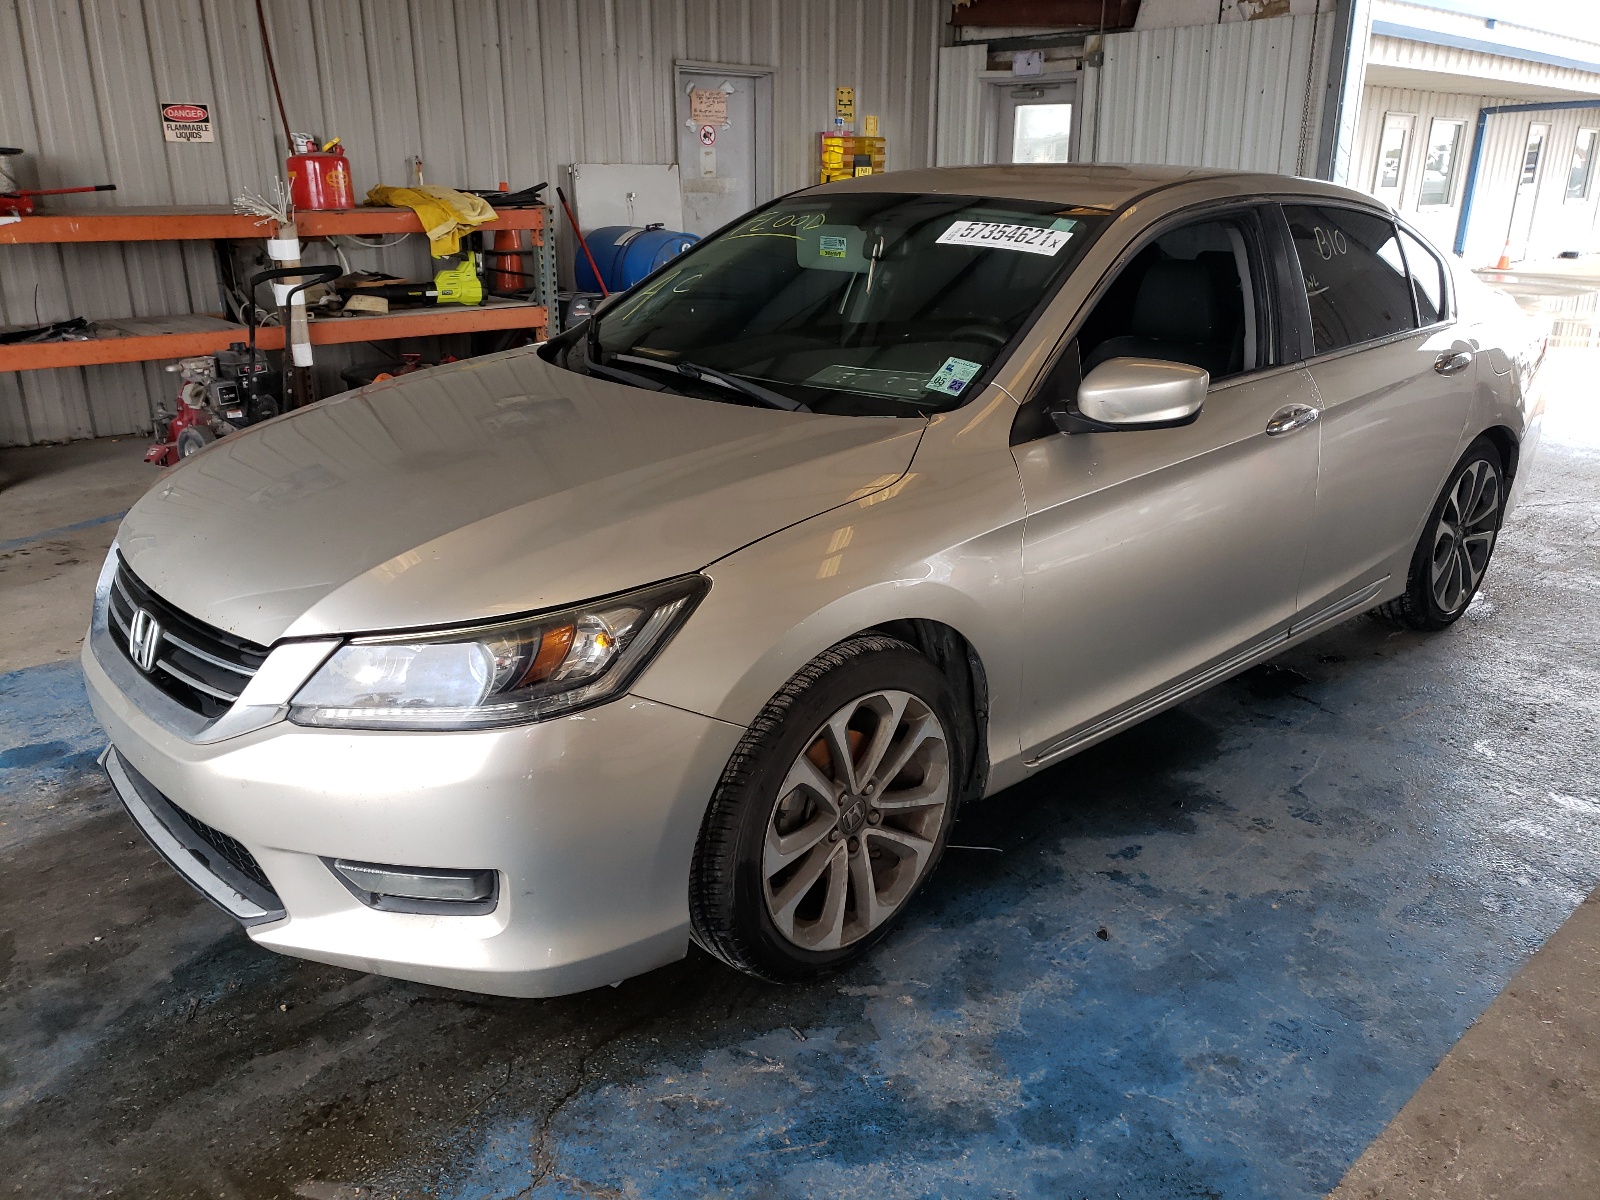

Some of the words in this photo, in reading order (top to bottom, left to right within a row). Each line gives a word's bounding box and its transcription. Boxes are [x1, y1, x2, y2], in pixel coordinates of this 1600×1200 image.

[168, 110, 204, 118] DANGER
[166, 124, 209, 132] FLAMMABLE
[960, 223, 1055, 246] 57354621
[934, 376, 947, 387] 05
[949, 380, 963, 391] 23
